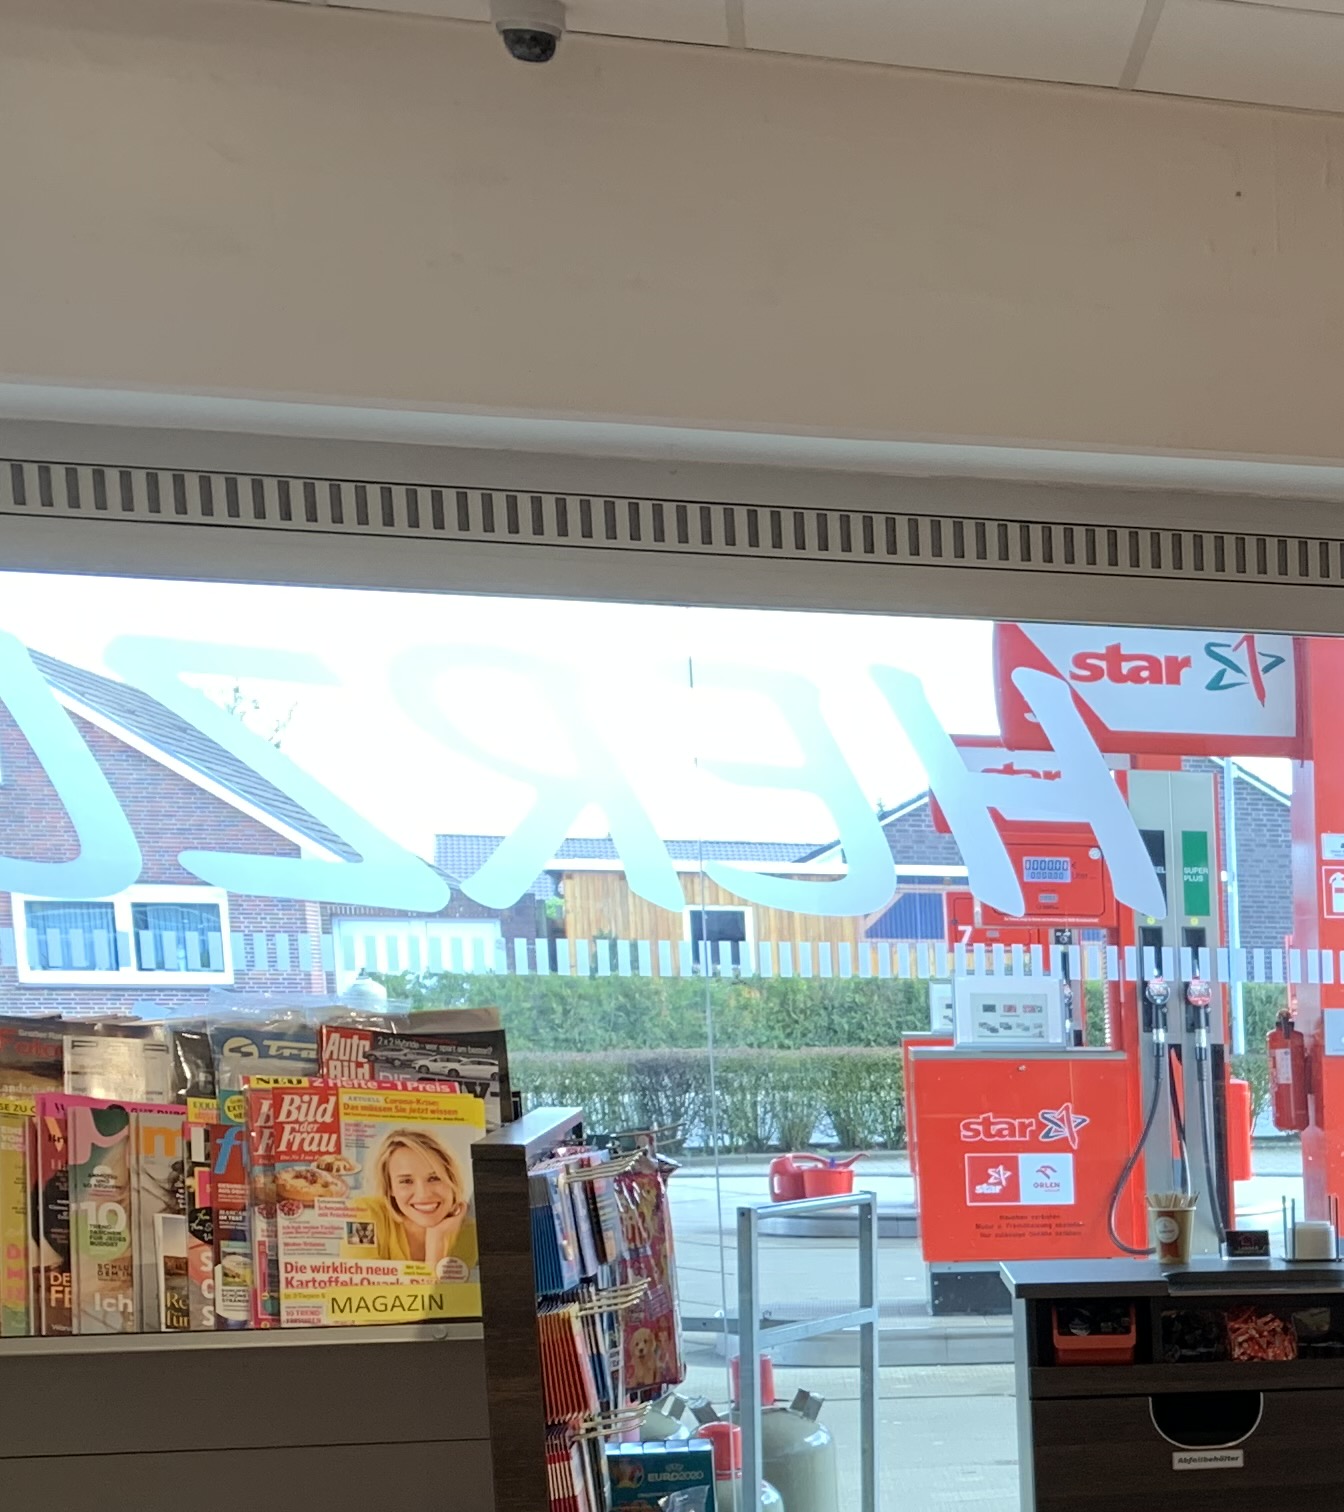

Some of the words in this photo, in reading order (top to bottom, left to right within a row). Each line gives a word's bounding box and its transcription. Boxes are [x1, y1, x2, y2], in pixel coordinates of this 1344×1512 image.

[1068, 642, 1192, 686] star
[1183, 866, 1209, 875] SUPER
[1183, 874, 1204, 882] PLUS
[956, 925, 973, 943] 7
[326, 1033, 370, 1061] Auto
[256, 1077, 302, 1086] NEU
[408, 1081, 450, 1093] Preis
[277, 1094, 336, 1123] Bild
[343, 1103, 360, 1113] Das
[361, 1103, 393, 1113] müssen
[395, 1105, 407, 1114] Sie
[430, 1107, 458, 1116] wissen
[299, 1121, 319, 1131] der
[960, 1112, 1037, 1142] star
[276, 1123, 337, 1153] Frau
[974, 1183, 1002, 1195] star
[1033, 1182, 1061, 1190] ORLEN
[78, 1202, 126, 1232] 10
[284, 1261, 306, 1275] Die
[311, 1261, 363, 1276] wirklich
[366, 1264, 398, 1277] neue
[331, 1293, 444, 1315] MAGAZIN
[647, 1471, 704, 1483] EURO2020
